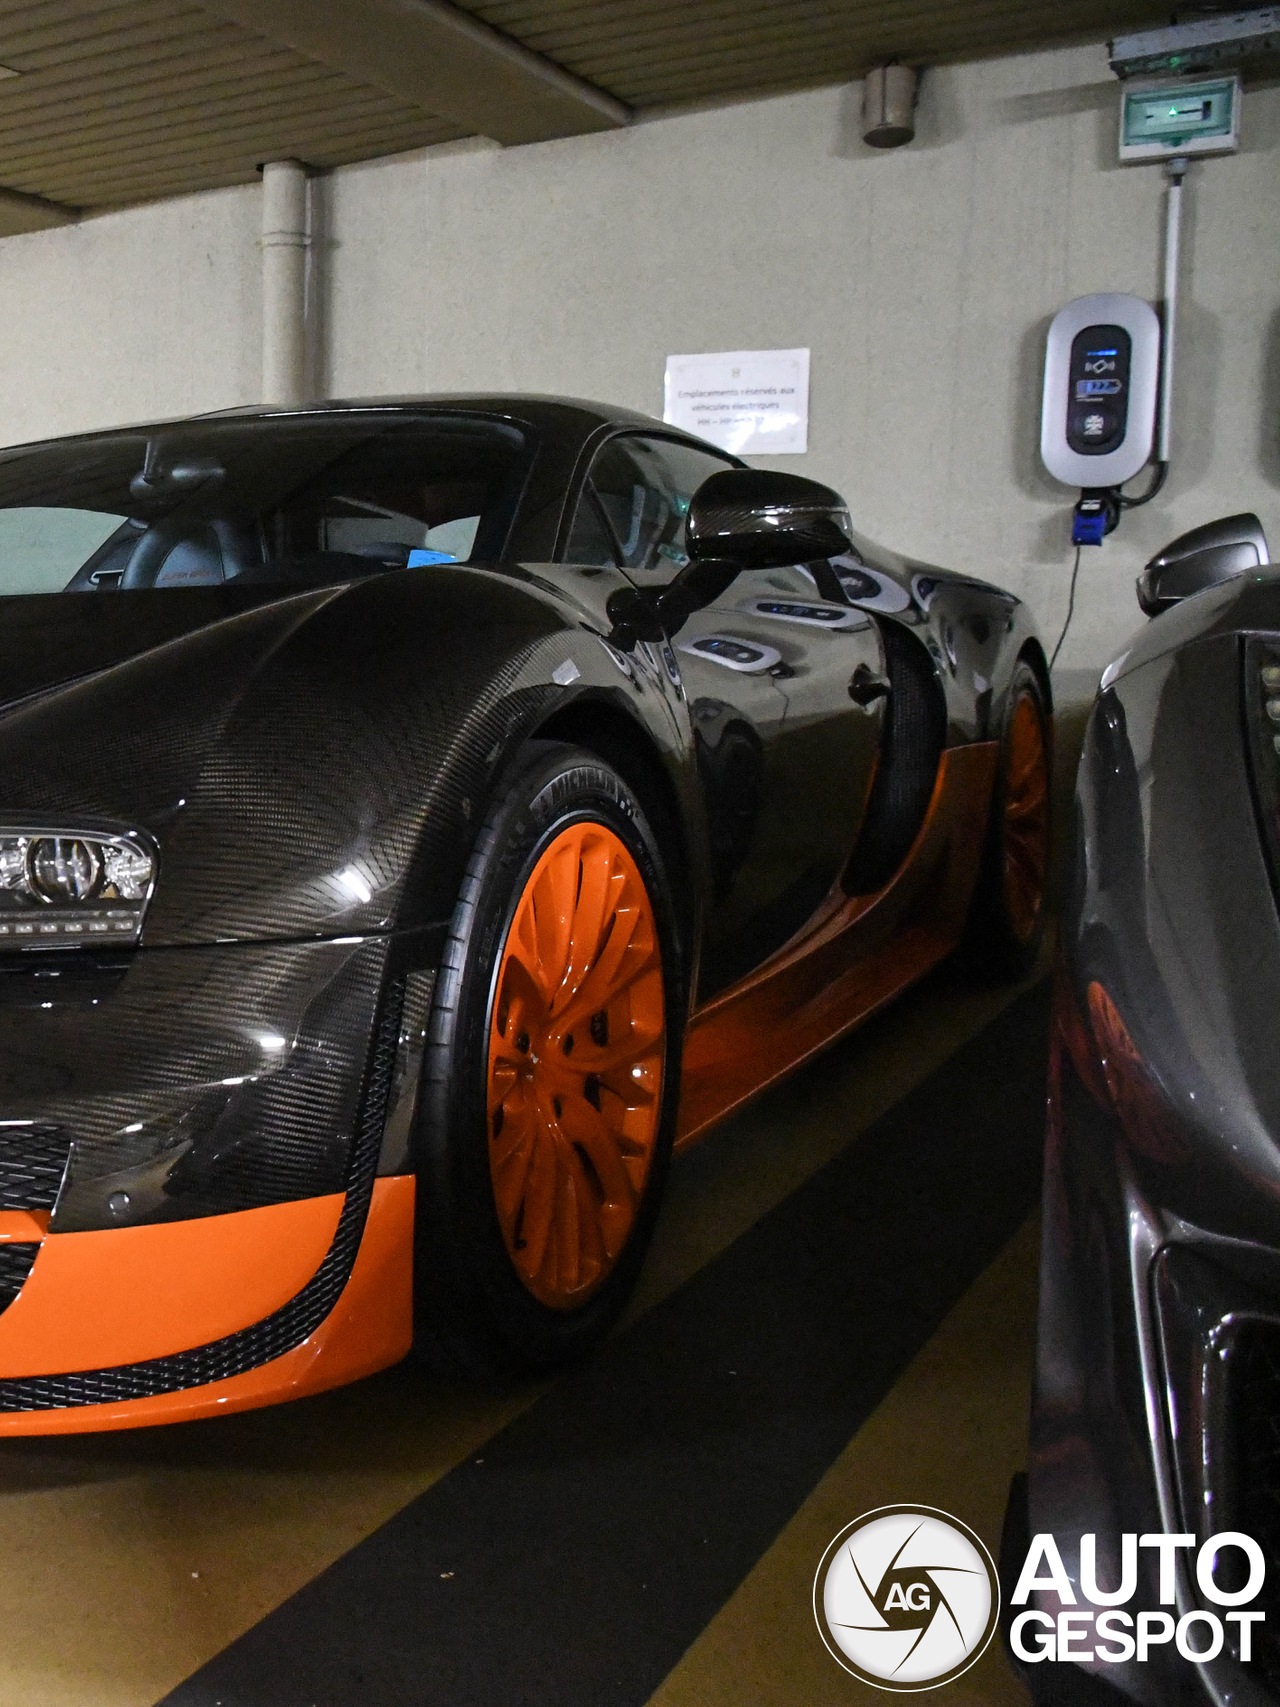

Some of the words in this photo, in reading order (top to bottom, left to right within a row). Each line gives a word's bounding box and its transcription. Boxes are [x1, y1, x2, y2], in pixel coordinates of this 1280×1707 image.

[678, 388, 738, 399] Emplacements
[741, 386, 777, 396] réservés
[780, 387, 795, 395] aux
[692, 402, 730, 412] véhicules
